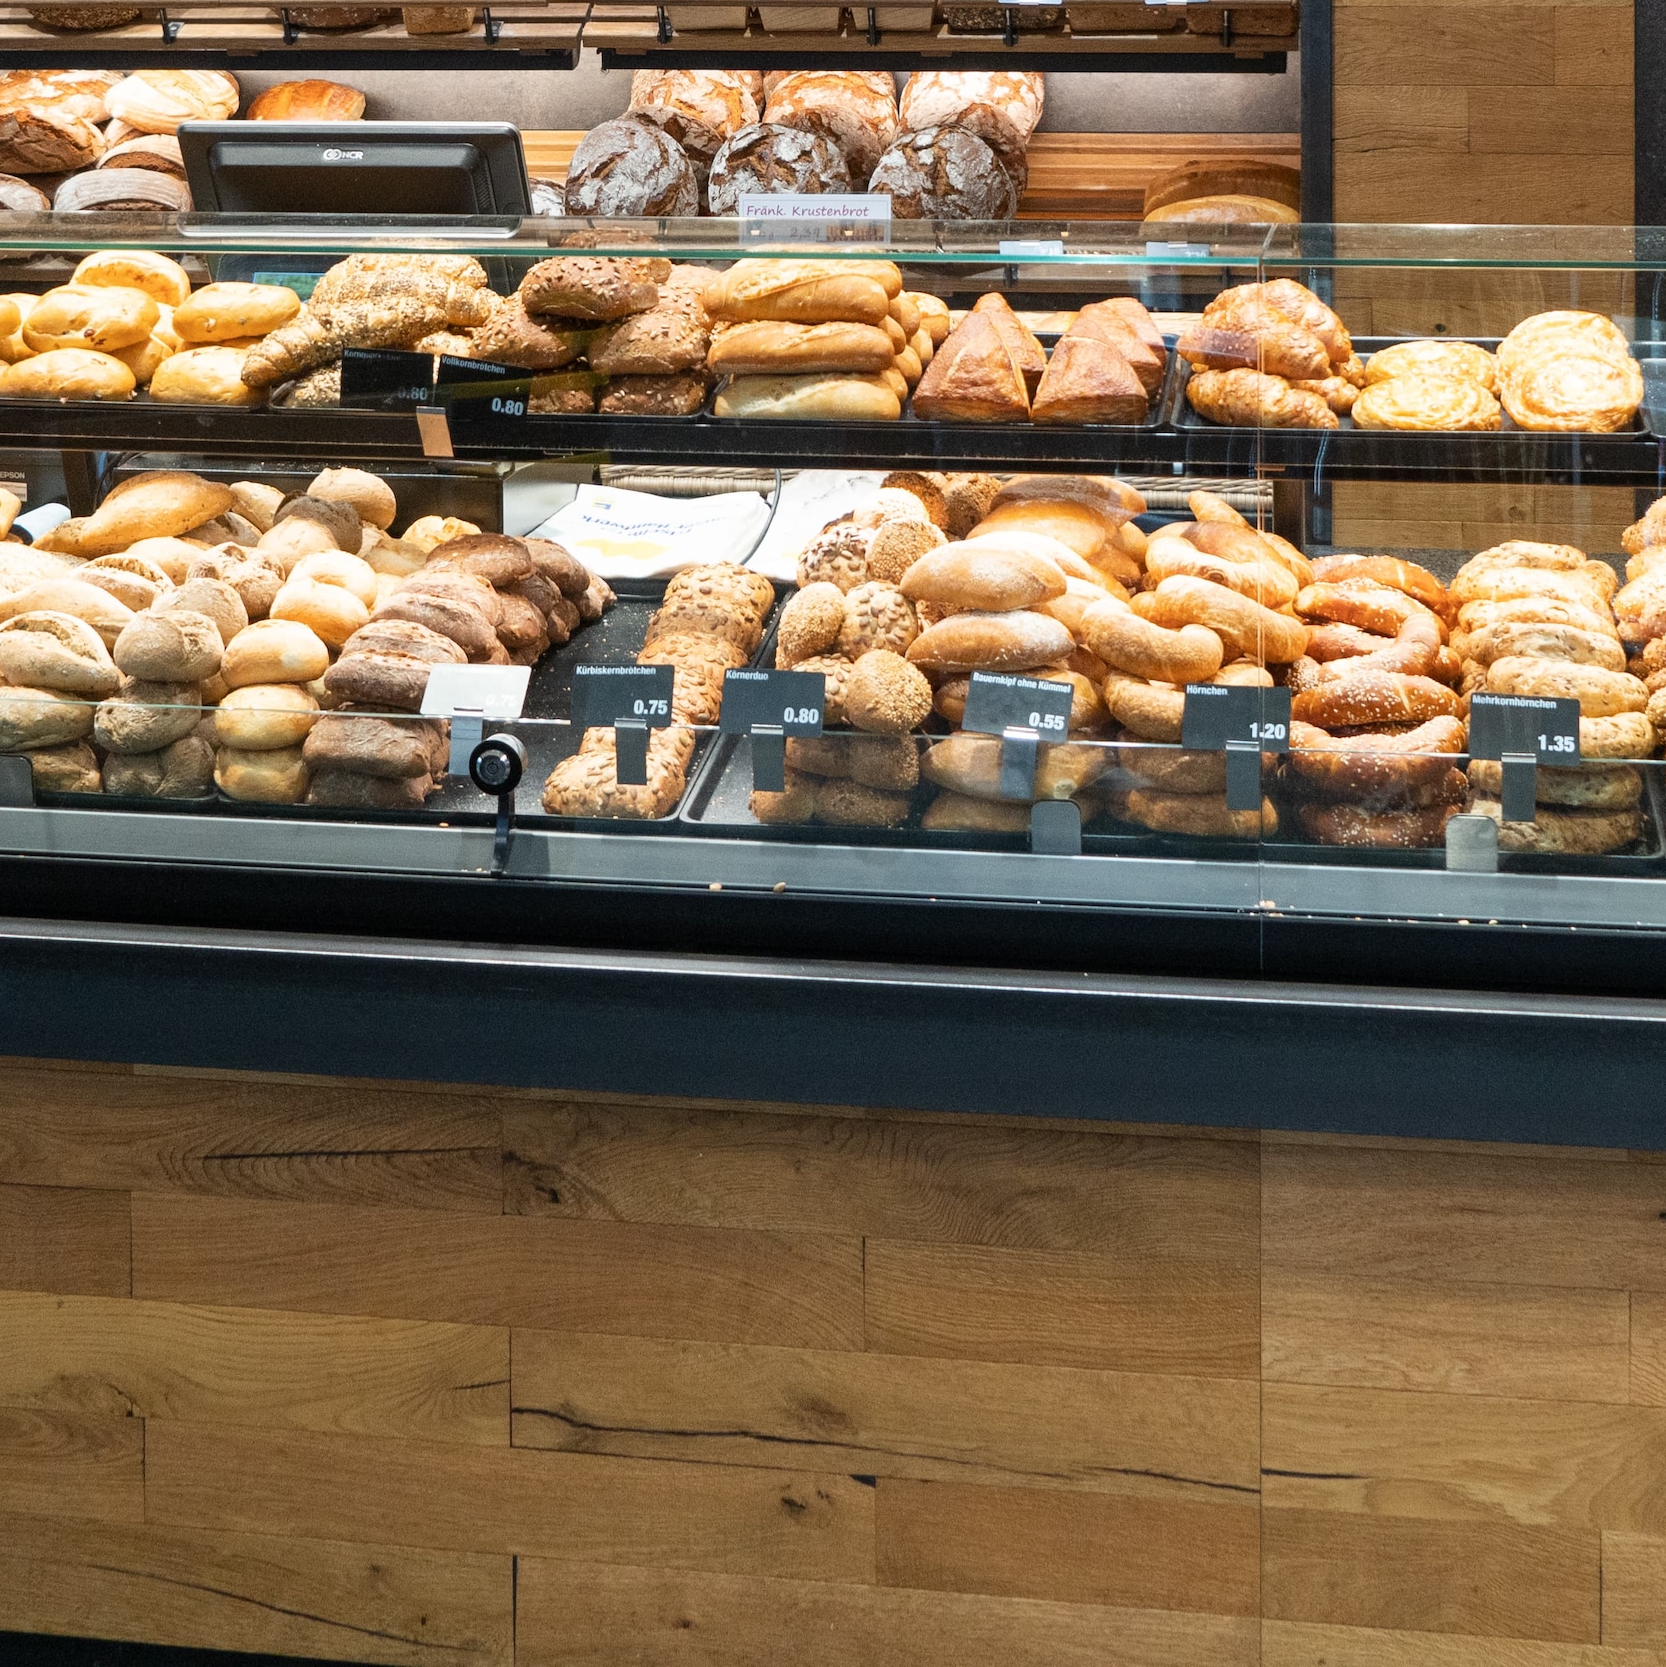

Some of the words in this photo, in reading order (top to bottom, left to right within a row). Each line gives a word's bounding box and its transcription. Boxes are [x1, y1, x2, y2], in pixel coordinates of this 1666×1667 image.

[342, 151, 364, 160] NCR
[746, 204, 786, 217] Fränk.
[792, 204, 869, 217] Krustenbrot
[442, 355, 506, 375] Vollkornbrötchen
[491, 397, 524, 416] 0.80
[0, 471, 25, 479] EPSON
[576, 665, 656, 675] Kürbiskernbrötchen
[726, 669, 769, 680] Körnerduo
[972, 671, 1016, 687] Bauernkipf
[1017, 678, 1037, 690] ohne
[1038, 680, 1071, 694] Kümmel
[1186, 684, 1228, 695] Hörnchen
[634, 700, 668, 715] 0.75
[1472, 694, 1557, 709] Mehrkornhörnchen
[783, 707, 819, 724] 0.80
[1028, 712, 1065, 731] 0.55
[1249, 723, 1286, 740] 1.20
[1538, 734, 1575, 752] 1.35
